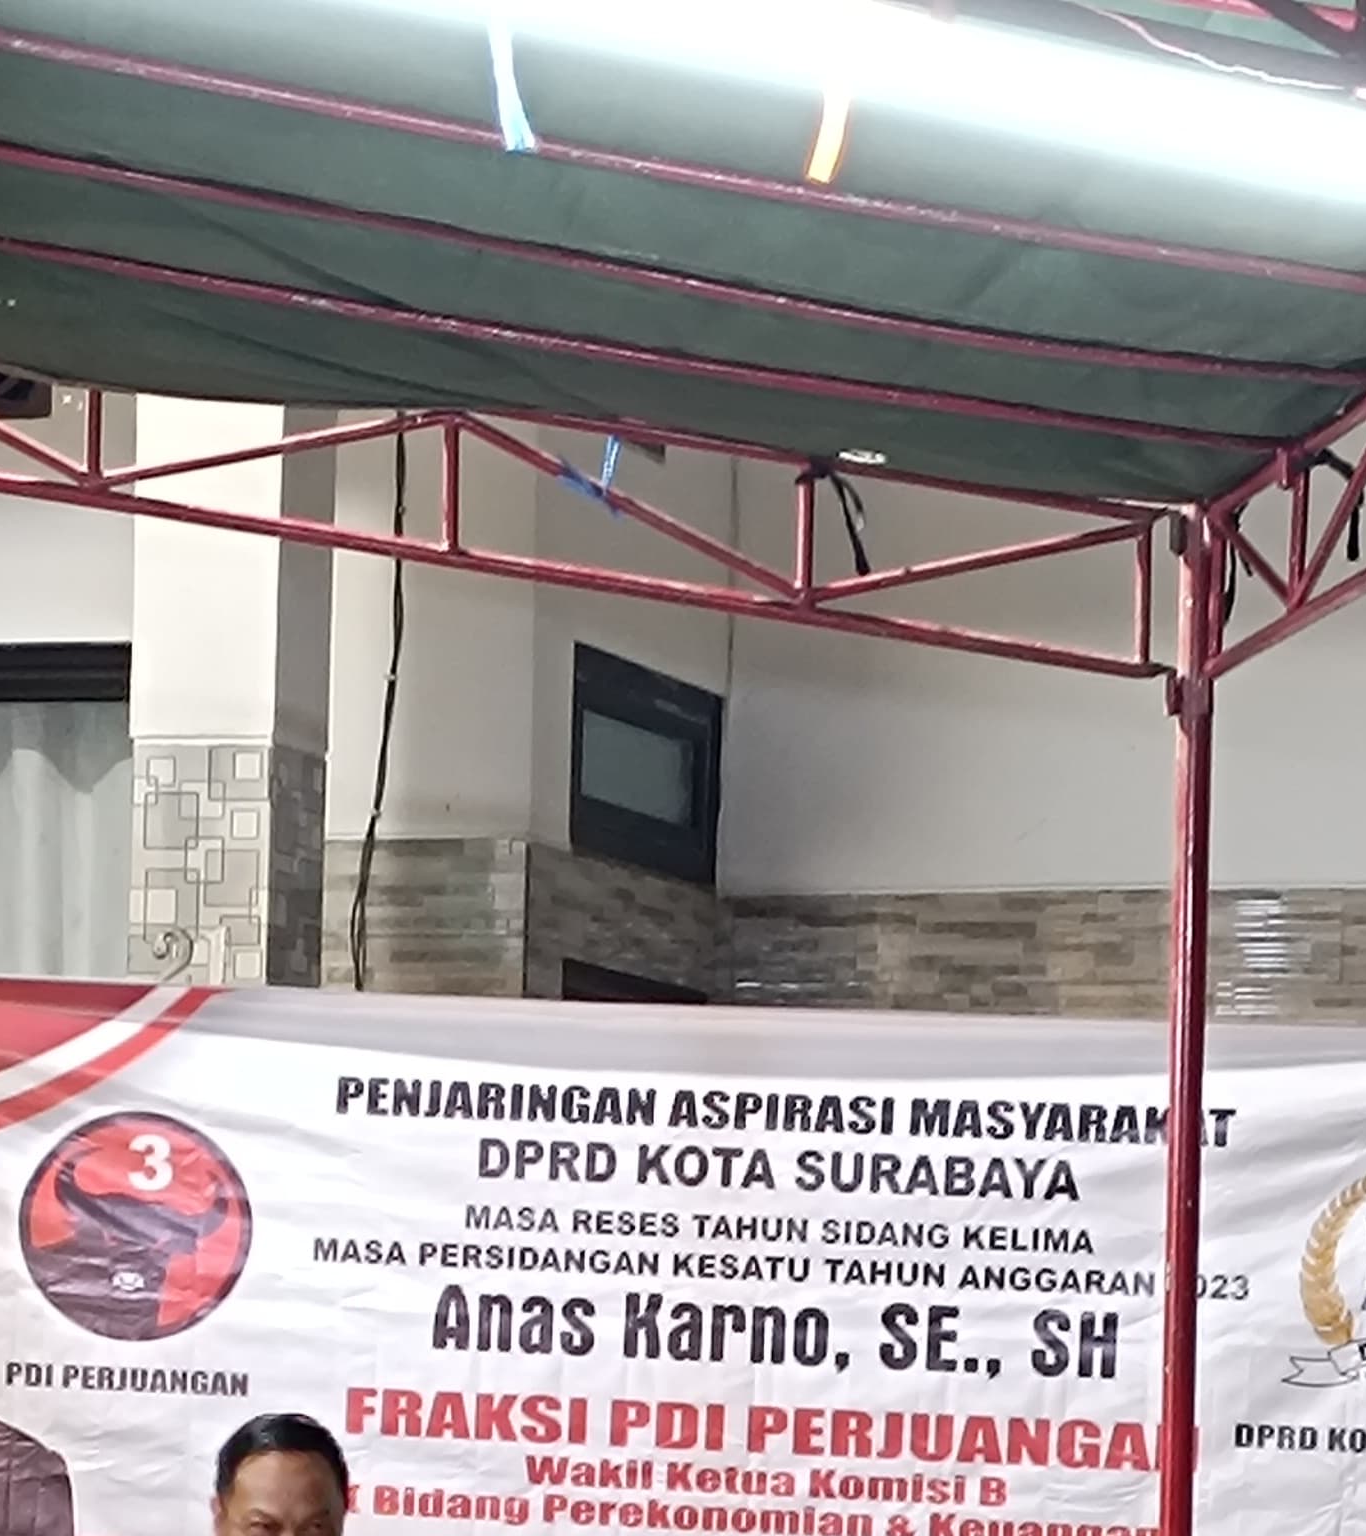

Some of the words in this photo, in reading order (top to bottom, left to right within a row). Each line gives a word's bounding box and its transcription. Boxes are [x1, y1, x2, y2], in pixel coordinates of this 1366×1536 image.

[335, 1076, 656, 1127] PENJARINGAN
[667, 1090, 894, 1136] ASPIRASI
[909, 1098, 1237, 1148] MASYARAKT
[128, 1134, 173, 1191] 3
[477, 1138, 617, 1183] DPRD
[636, 1144, 776, 1190] KOTA
[795, 1150, 1080, 1201] SURABAYA
[464, 1204, 560, 1235] MASA
[572, 1209, 680, 1239] RESES
[692, 1213, 808, 1245] TAHUN
[821, 1219, 950, 1250] SIDANG
[962, 1225, 1095, 1255] KELIMA
[312, 1237, 407, 1266] MASA
[418, 1242, 661, 1277] PERSIDANGAN
[672, 1251, 810, 1284] KESATU
[825, 1257, 946, 1289] TAHUN
[958, 1264, 1157, 1298] ANGGARAN
[432, 1283, 596, 1356] Anas
[622, 1292, 851, 1374] Karno,
[878, 1302, 1002, 1380] SE.,
[1030, 1308, 1120, 1380] SH
[5, 1362, 54, 1387] PDI
[61, 1364, 249, 1397] PERJUANGAN
[345, 1387, 588, 1445] FRAKSI
[609, 1399, 725, 1452] PDI
[1234, 1422, 1319, 1450] DPRD
[372, 1485, 529, 1526] Bidang
[524, 1455, 654, 1490] Wakil
[666, 1461, 795, 1498] Ketua
[809, 1468, 966, 1505] Komisi
[979, 1476, 1007, 1507] B
